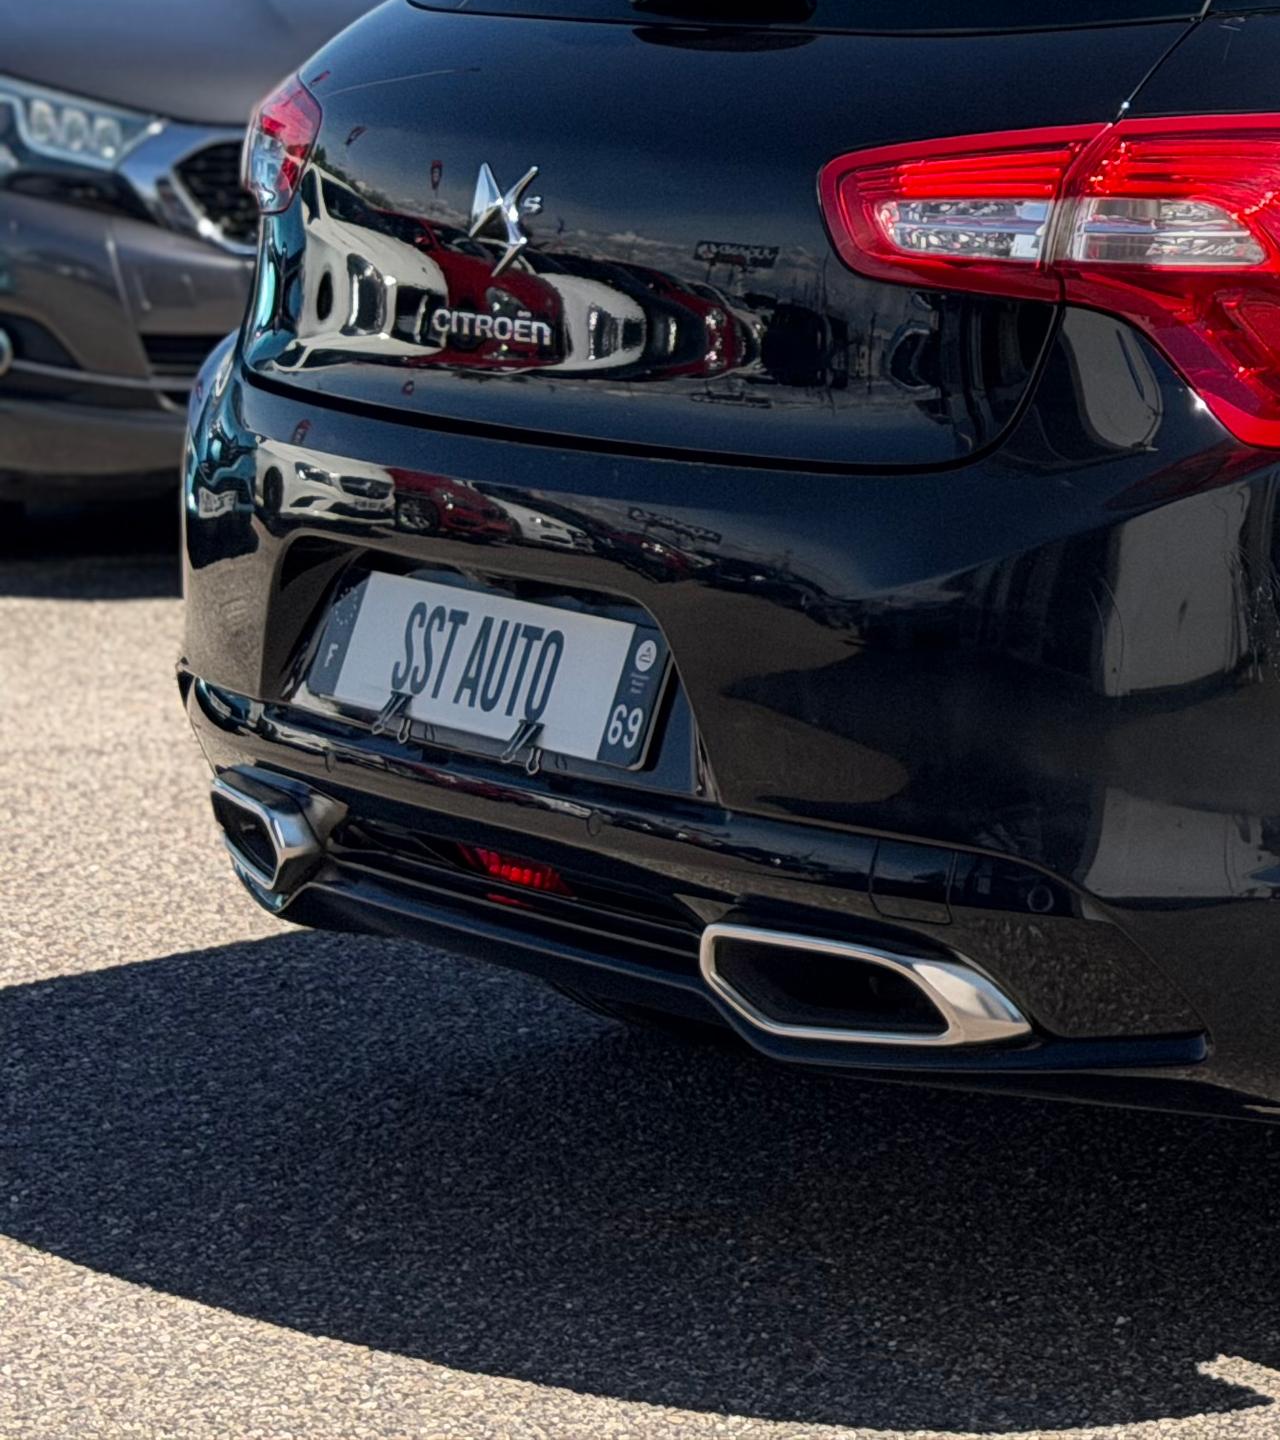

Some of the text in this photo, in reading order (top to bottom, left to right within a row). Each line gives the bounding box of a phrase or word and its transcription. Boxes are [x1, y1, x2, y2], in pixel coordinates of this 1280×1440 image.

[391, 601, 565, 721] SST AUTO
[607, 704, 644, 749] 69
